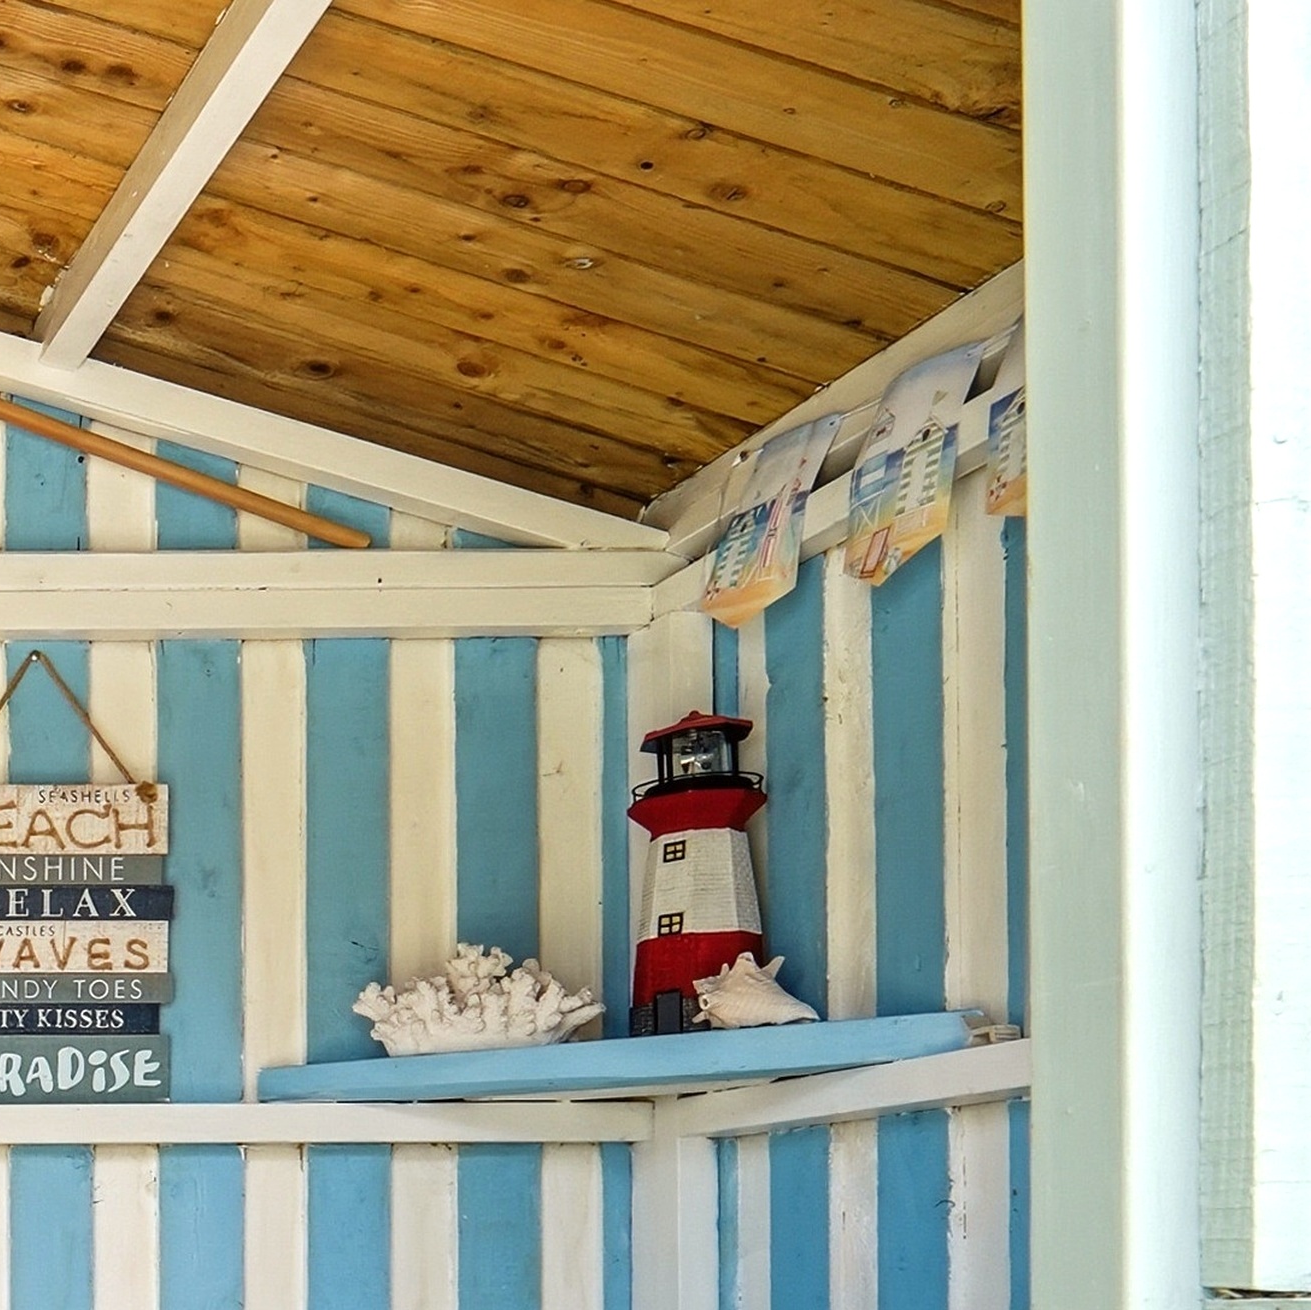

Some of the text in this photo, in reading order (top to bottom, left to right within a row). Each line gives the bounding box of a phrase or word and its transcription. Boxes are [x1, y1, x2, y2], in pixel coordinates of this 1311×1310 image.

[38, 789, 131, 804] SEASHELLS
[73, 979, 143, 1000] TOES
[36, 1008, 125, 1029] KISSES
